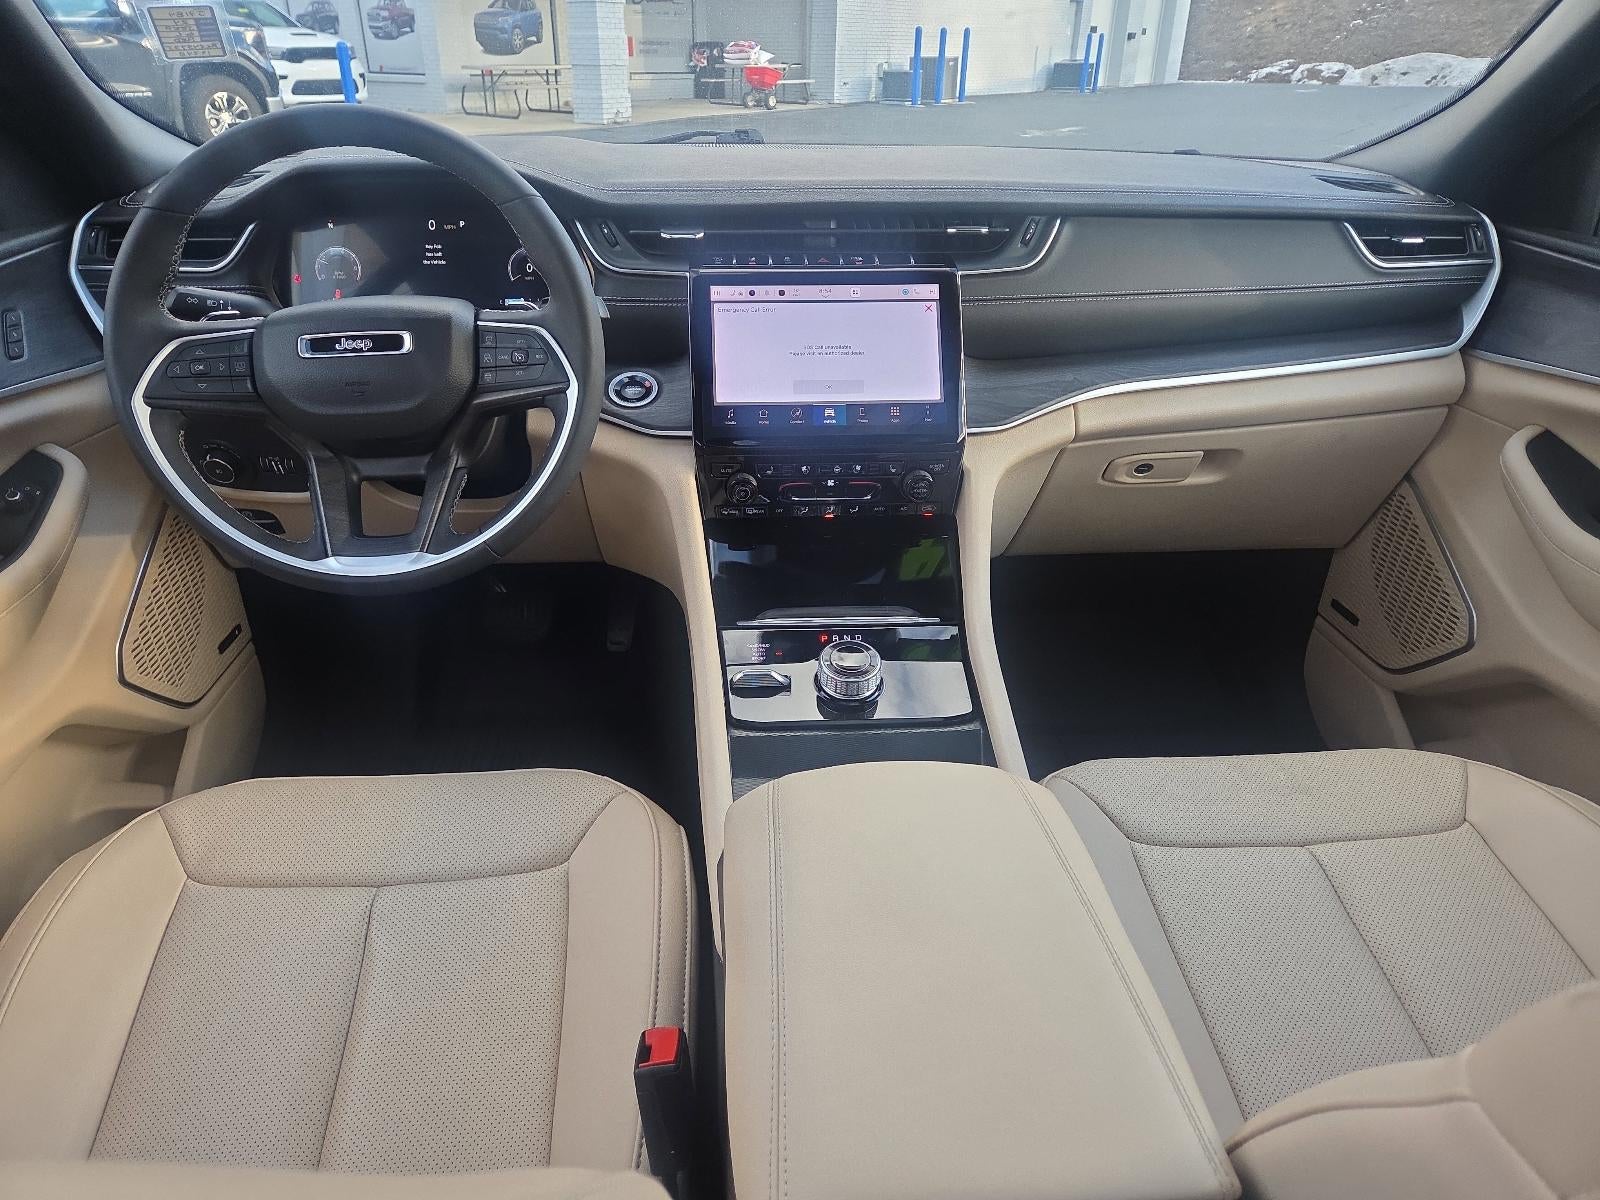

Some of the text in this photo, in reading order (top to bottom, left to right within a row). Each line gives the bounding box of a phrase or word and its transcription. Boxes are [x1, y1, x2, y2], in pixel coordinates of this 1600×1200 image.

[429, 220, 436, 230] 0
[460, 220, 465, 228] P
[526, 263, 533, 272] 0
[335, 338, 373, 350] Jeep
[821, 635, 828, 643] P
